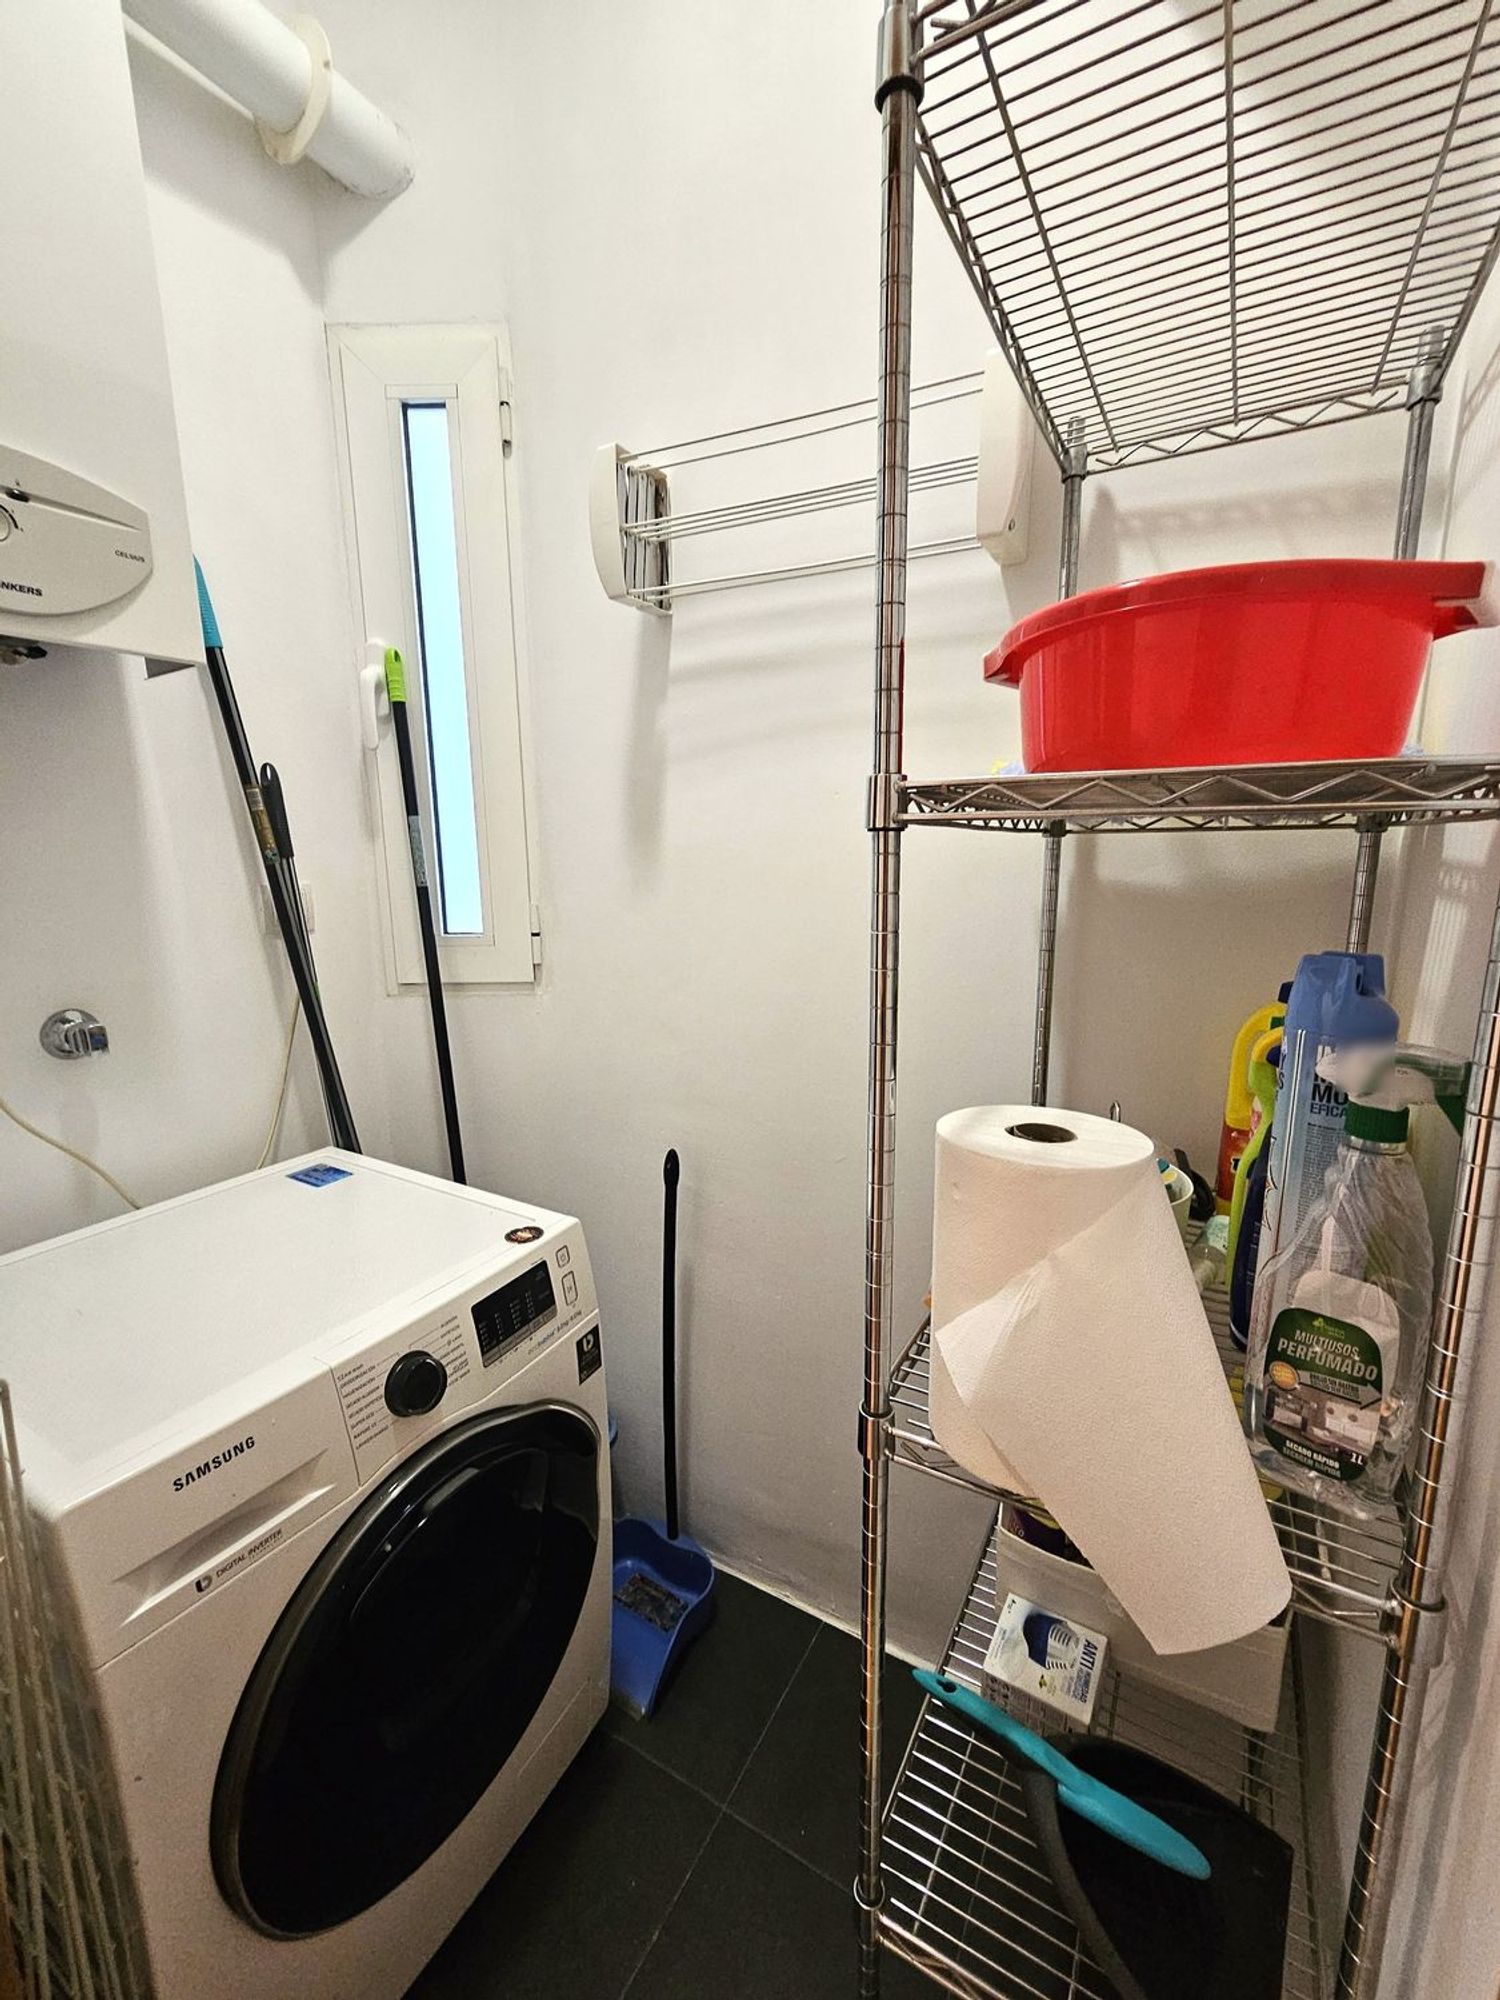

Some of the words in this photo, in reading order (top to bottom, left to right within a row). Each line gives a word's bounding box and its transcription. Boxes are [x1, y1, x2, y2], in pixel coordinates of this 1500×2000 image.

[1277, 1337, 1378, 1381] PERFUMADO
[1294, 1328, 1360, 1359] MULTIUSOS
[172, 1436, 255, 1492] SAMSUNG
[1285, 1439, 1313, 1459] SECADO
[215, 1554, 247, 1578] DIGITAL
[1080, 1638, 1099, 1671] ANTI
